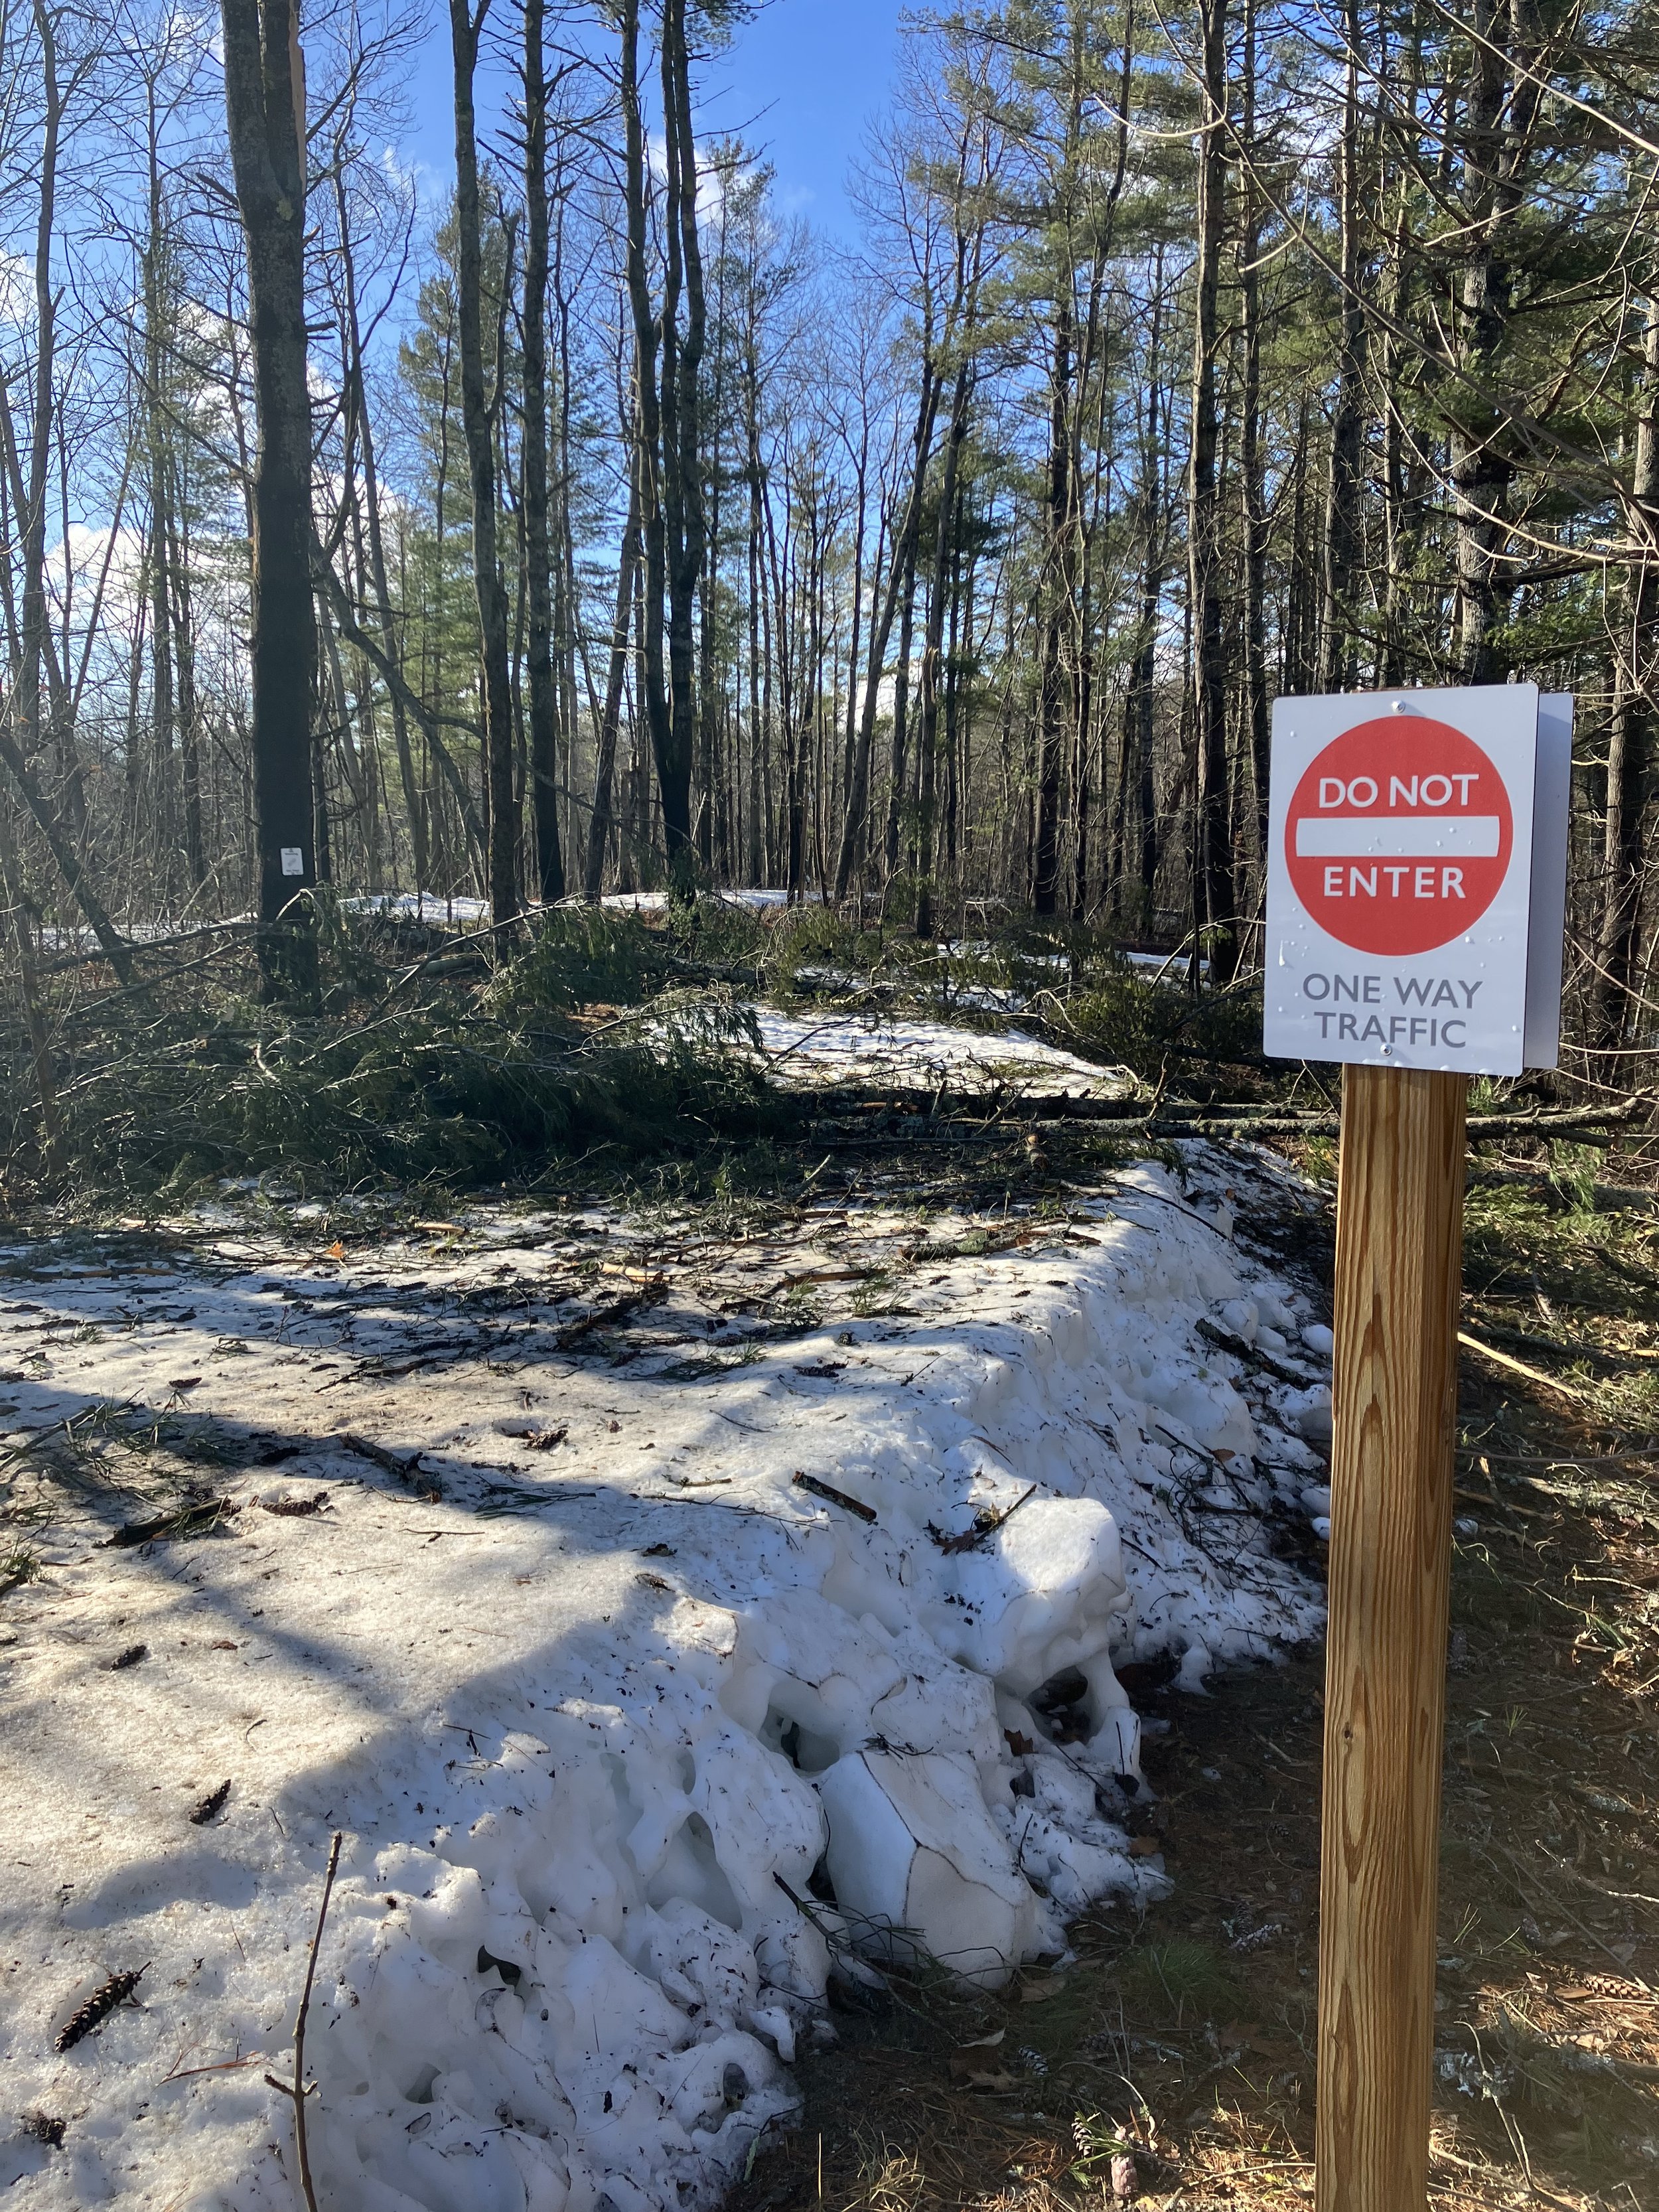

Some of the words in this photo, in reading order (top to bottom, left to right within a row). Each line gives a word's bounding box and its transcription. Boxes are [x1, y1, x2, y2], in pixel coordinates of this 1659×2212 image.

[1319, 776, 1378, 808] DO
[1389, 774, 1480, 807] NOT
[1323, 866, 1466, 899] ENTER
[1303, 973, 1381, 1004] ONE
[1394, 977, 1483, 1009] WAY
[1314, 1011, 1467, 1048] TRAFFIC
